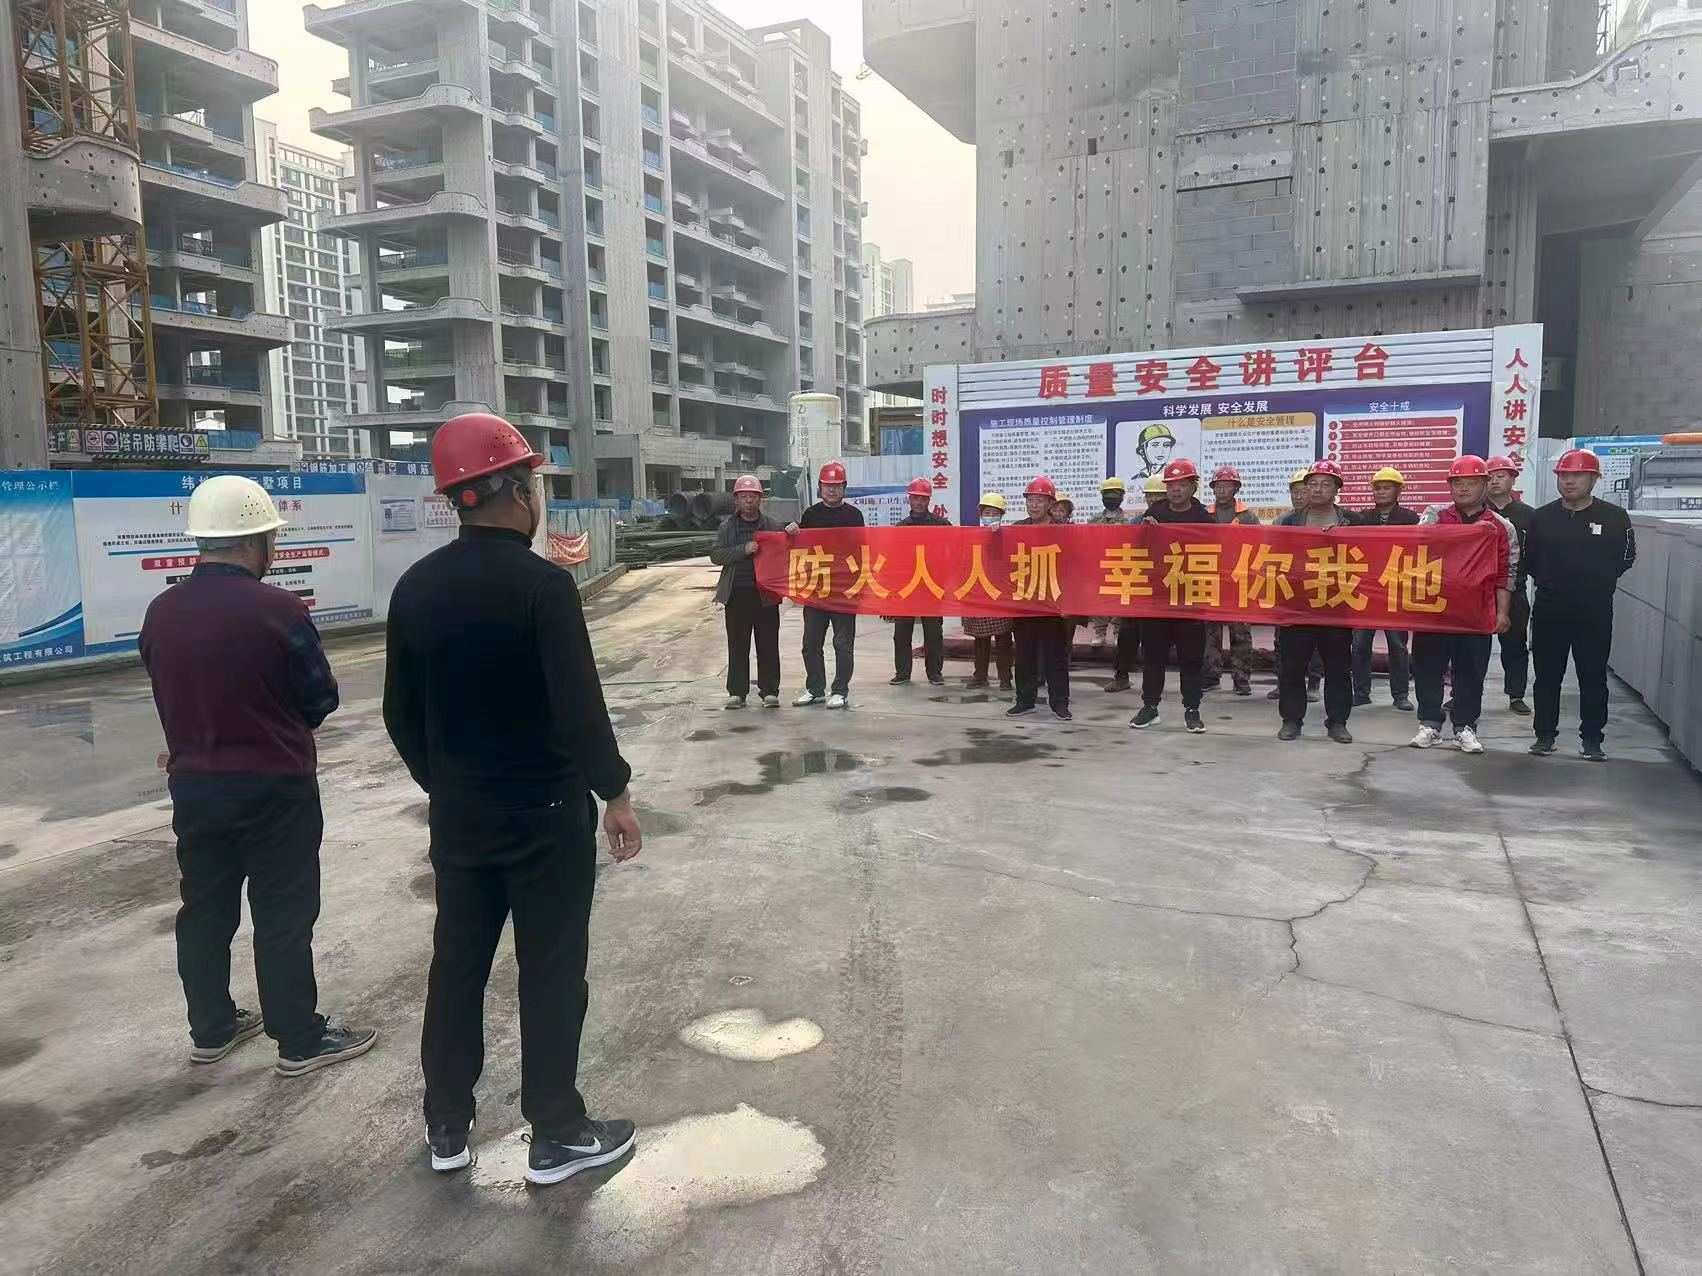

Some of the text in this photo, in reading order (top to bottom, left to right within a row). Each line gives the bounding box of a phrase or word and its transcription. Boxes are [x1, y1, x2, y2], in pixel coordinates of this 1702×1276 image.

[1038, 343, 1390, 398] 质量安全讲评台
[1163, 400, 1269, 417] 科学发展 安全发展
[1369, 401, 1411, 412] 安全十戒
[990, 415, 1094, 428] 施工现场质量控制管理制度
[1227, 415, 1295, 427] 什么是安全管理
[119, 432, 179, 453] 塔吊防攀爬
[931, 386, 948, 490] 时时想安全
[309, 462, 356, 473] 钢筋加工棚
[408, 463, 429, 475] 钢筋
[788, 541, 1448, 613] 防火人人抓 幸福你我他
[3, 645, 73, 661] 筑工程有限公司
